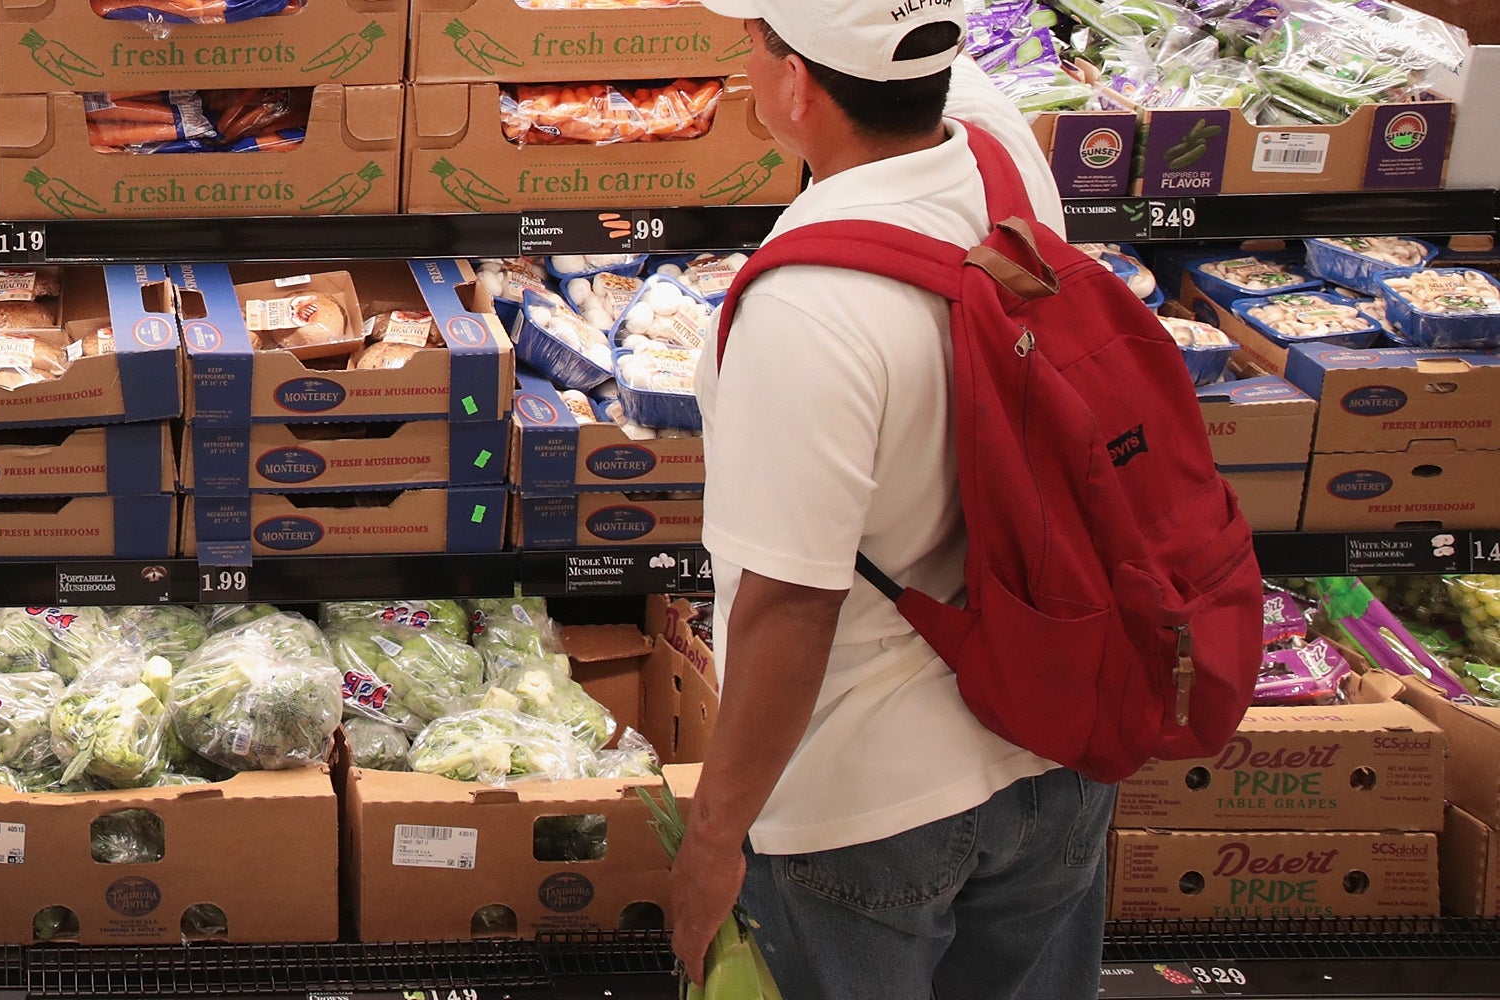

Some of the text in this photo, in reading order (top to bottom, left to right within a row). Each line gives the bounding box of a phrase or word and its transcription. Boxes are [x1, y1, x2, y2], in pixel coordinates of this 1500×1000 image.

[532, 32, 711, 57] fresh carrots
[110, 42, 296, 67] fresh carrots
[1081, 146, 1120, 158] SUNSET
[517, 168, 696, 193] fresh carrots
[1162, 171, 1198, 179] INSPIRED
[1161, 178, 1211, 188] FLAVOR
[113, 179, 294, 203] fresh carrots
[1064, 205, 1117, 214] CUCUMBERS
[521, 217, 546, 226] BABY
[1151, 207, 1195, 227] 2.49
[521, 226, 563, 235] CARROTS
[634, 218, 664, 240] .99
[0, 397, 33, 406] FRESH
[40, 388, 104, 402] MUSHROOMS
[284, 391, 339, 402] MONTEREY
[350, 389, 381, 397] FRESH
[1349, 397, 1400, 409] MONTEREY
[1382, 419, 1492, 430] FRESH MUSHROOMS
[594, 455, 692, 471] MONTEREY FRESH
[4, 467, 36, 476] FRESH
[39, 465, 106, 475] MUSHROOMS
[1350, 540, 1413, 549] WHITE SLICED
[1474, 540, 1500, 561] 1.4
[1350, 549, 1405, 559] MUSHROOMS
[569, 556, 634, 567] WHOLE WHITE
[569, 567, 624, 577] MUSHROOMS
[680, 558, 712, 579] 1.4
[59, 573, 116, 583] PORTABELLA
[202, 570, 247, 593] 1.99
[59, 582, 116, 592] MUSHROOMS
[1374, 737, 1431, 752] SCSglobal
[1214, 736, 1341, 771] Desert
[1233, 769, 1323, 797] PRIDE
[1216, 797, 1338, 810] TABLE GRAPES
[1212, 841, 1339, 877] Desert
[1229, 878, 1318, 904] PRIDE
